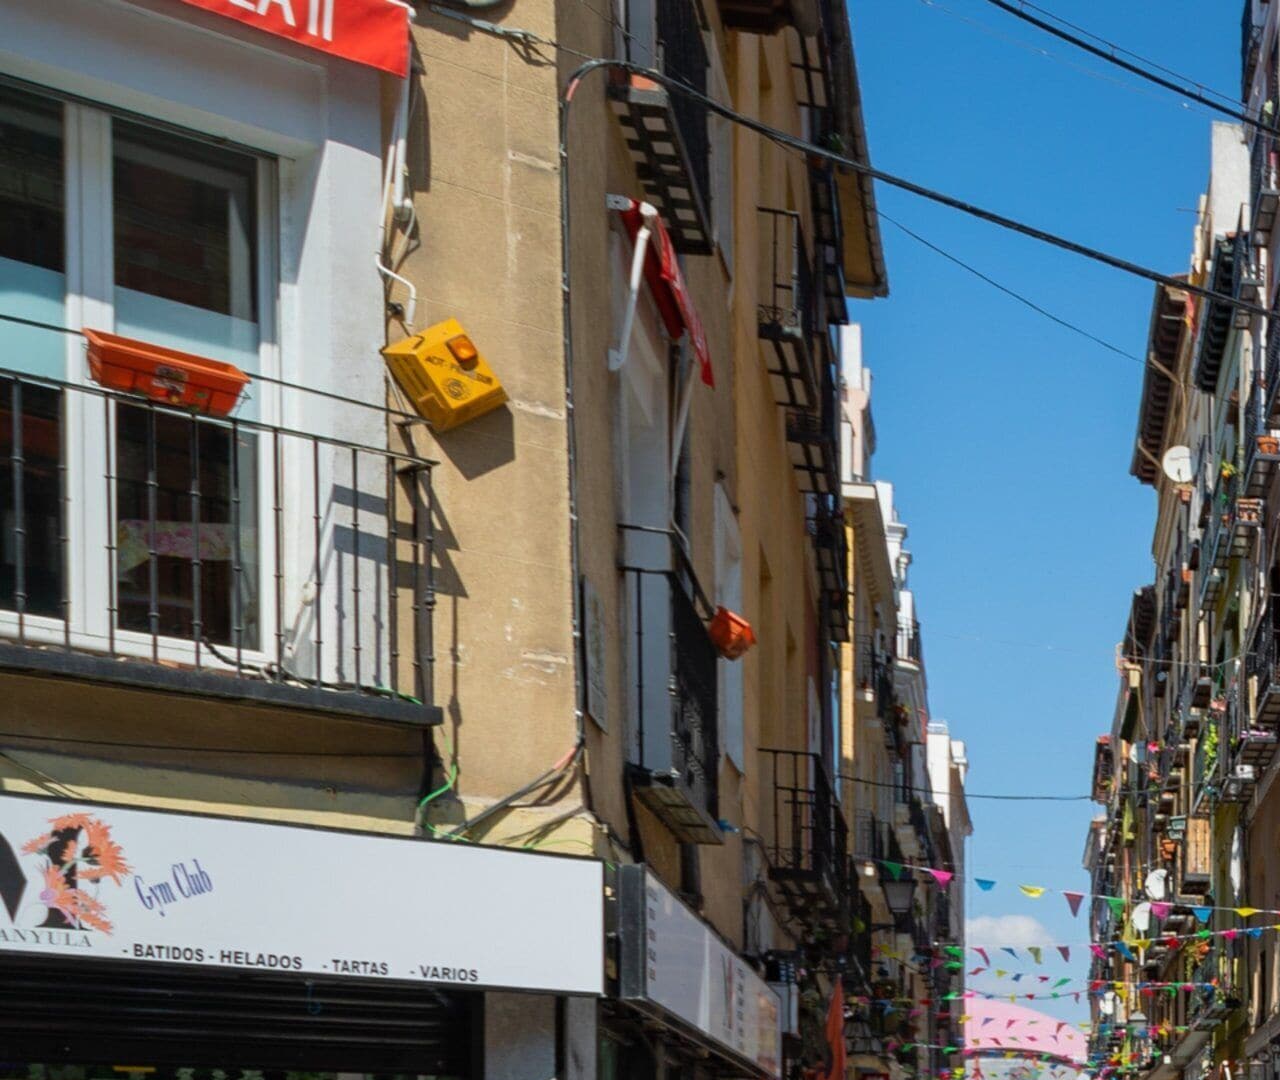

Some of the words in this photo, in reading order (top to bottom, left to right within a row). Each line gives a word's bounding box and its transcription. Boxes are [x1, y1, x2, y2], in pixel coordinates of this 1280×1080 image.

[134, 874, 177, 917] Gym
[172, 858, 213, 899] Club
[133, 943, 204, 962] BATIDOS
[220, 950, 303, 970] HELADOS
[331, 959, 389, 975] TARTAS
[420, 965, 479, 982] VARIOS
